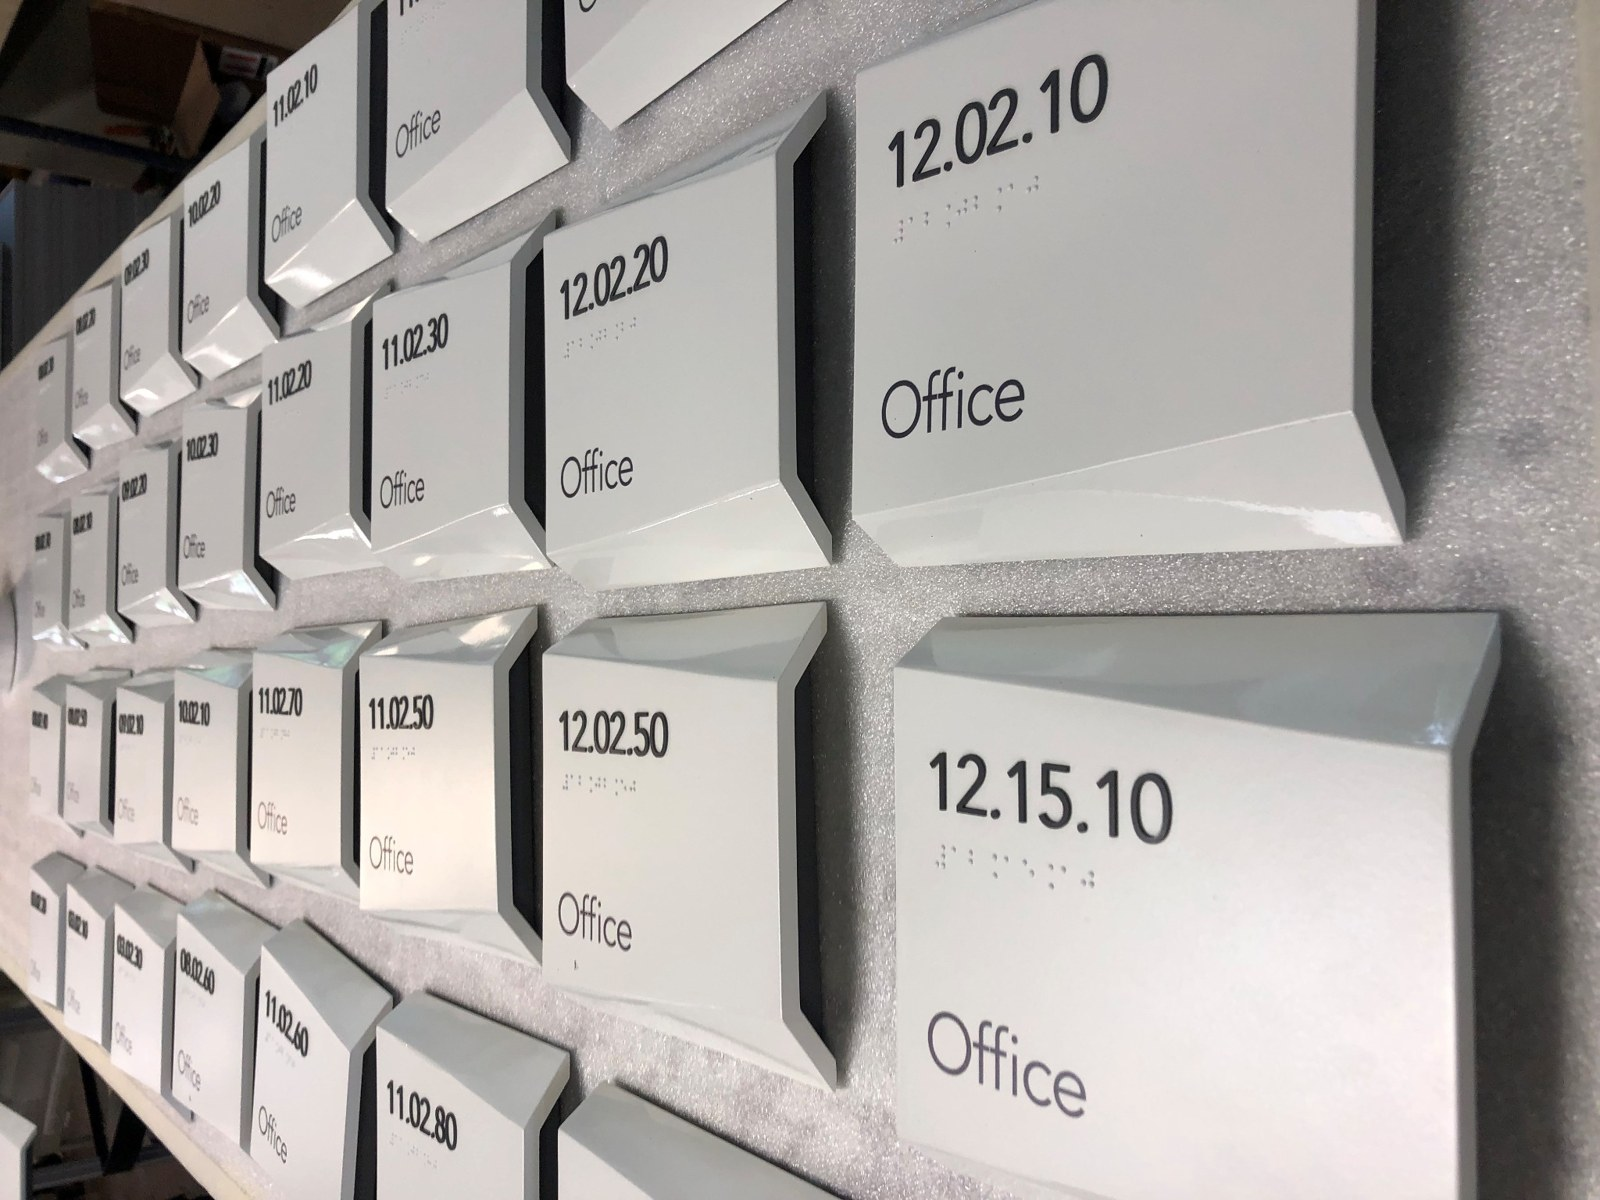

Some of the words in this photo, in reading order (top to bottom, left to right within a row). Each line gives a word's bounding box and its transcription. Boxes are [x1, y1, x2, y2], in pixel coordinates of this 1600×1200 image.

[272, 64, 317, 126] 11.02.10
[396, 110, 441, 158] Office
[888, 54, 1108, 188] 12.02.10
[188, 181, 221, 227] 10.02.20
[272, 206, 302, 243] Office
[560, 236, 668, 320] 12.02.20
[187, 294, 209, 324] Office
[383, 313, 448, 370] 11.02.30
[268, 360, 312, 405] 11.02.20
[882, 367, 1025, 438] Office
[187, 432, 218, 461] 10.02.30
[380, 470, 424, 508] Office
[561, 448, 633, 498] Office
[266, 487, 296, 518] Office
[183, 534, 205, 559] Office
[179, 700, 210, 726] 10.02.10
[259, 687, 302, 716] 11.02.70
[369, 694, 434, 729] 11.02.50
[559, 710, 668, 758] 12.02.50
[177, 797, 198, 825] Office
[258, 802, 287, 835] Office
[930, 752, 1173, 844] 12.15.10
[370, 836, 413, 875] Office
[558, 892, 632, 951] Office
[266, 990, 308, 1057] 11.02.60
[178, 1050, 201, 1092] Office
[928, 1011, 1086, 1118] Office
[259, 1106, 287, 1163] Office
[387, 1080, 457, 1150] 11.02.80
